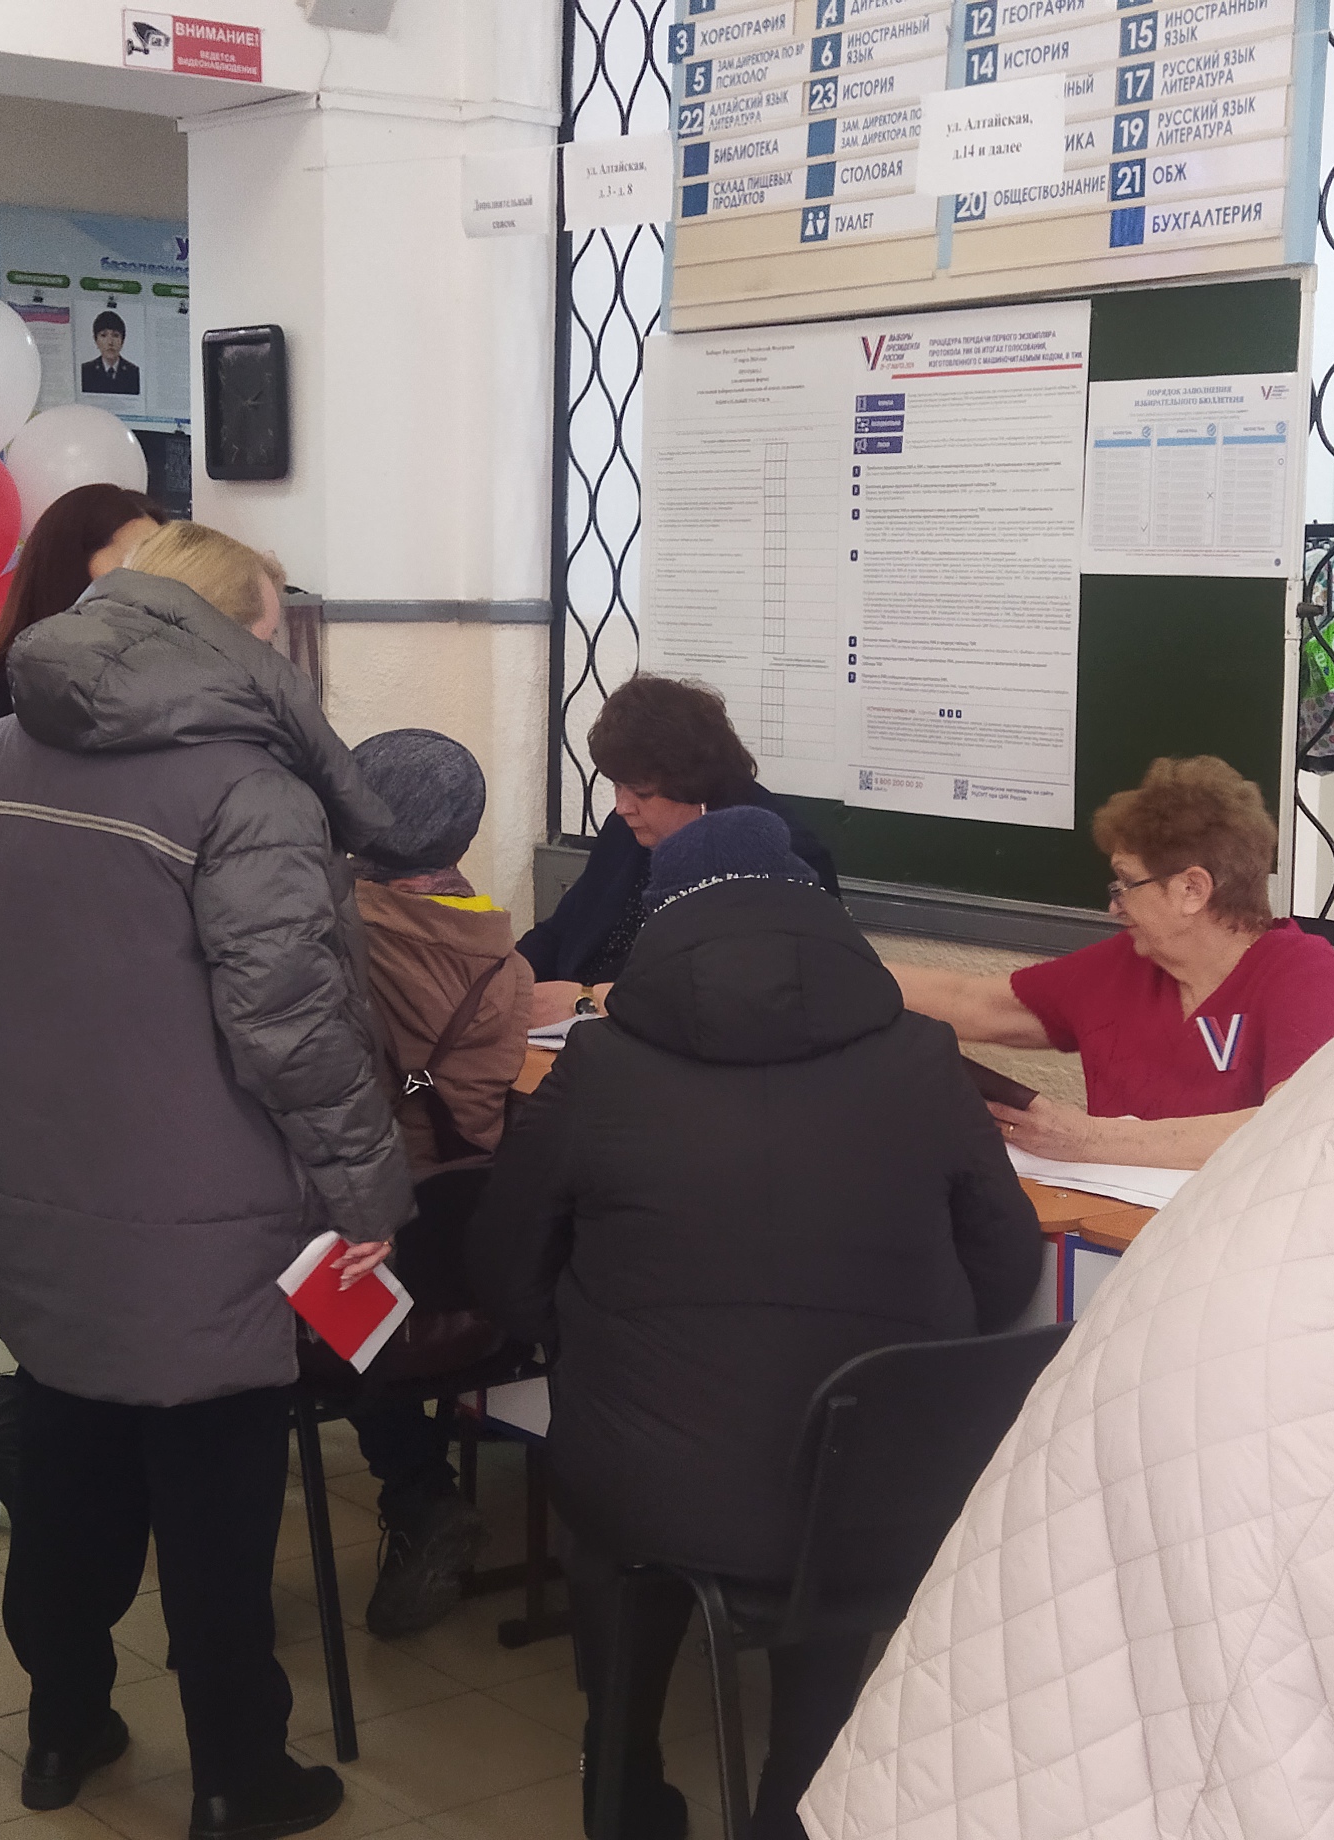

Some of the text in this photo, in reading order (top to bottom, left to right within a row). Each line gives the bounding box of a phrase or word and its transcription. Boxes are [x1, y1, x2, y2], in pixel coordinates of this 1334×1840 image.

[971, 7, 992, 36] 12
[1002, 0, 1085, 25] ГЕОГРАФИЯ
[1165, 0, 1267, 29] ИНОСТРАННЫЙ
[175, 22, 259, 47] ВНИМАНИЕ!
[675, 29, 688, 56] 3
[700, 13, 786, 47] ХОРЕОГРАФИЯ
[847, 14, 931, 49] ИНОСТРАННЫЙ
[1127, 19, 1153, 50] 15
[1164, 26, 1198, 47] ЯЗЫК
[782, 46, 794, 59] ПО
[822, 40, 834, 67] 6
[846, 46, 875, 65] ЯЗЫК
[1004, 41, 1070, 70] ИСТОРИЯ
[1162, 46, 1256, 78] РУССКИЙ ЯЗЫК
[177, 57, 258, 75] ВИДЕОНАБЛЮДЕНИЕ
[716, 66, 769, 90] ПСИХОЛОГ
[971, 51, 994, 81] 14
[693, 67, 705, 92] 5
[842, 76, 895, 100] ИСТОРИЯ
[1124, 69, 1151, 99] 17
[1161, 68, 1234, 96] ЛИТЕРАТУРА
[709, 90, 789, 117] АЛТАЙСКИЙ ЯЗЫК
[810, 82, 836, 110] 23
[680, 108, 703, 134] 22
[708, 110, 762, 132] ЛИТЕРАТУРА
[862, 110, 908, 129] ДИРЕКТОРА
[909, 107, 922, 120] ПО
[946, 113, 1033, 137] ул. Алтайская,
[1158, 96, 1256, 129] РУССКИЙ ЯЗЫК
[861, 126, 908, 146] ДИРЕКТОРА
[909, 124, 922, 137] ПО
[1120, 118, 1144, 148] 19
[1156, 119, 1233, 147] ЛИТЕРАТУРА
[714, 138, 780, 164] БИБЛИОТЕКА
[978, 147, 986, 156] и
[988, 142, 1022, 157] далее
[713, 171, 793, 196] СКЛАД ПИЩЕВЫХ
[841, 160, 903, 184] СТОЛОВАЯ
[1117, 165, 1140, 196] 21
[1153, 162, 1187, 185] ОБЖ
[627, 183, 633, 194] 8
[712, 190, 766, 211] ПРОДУКТОВ
[994, 175, 1106, 207] ОБЩЕСТВОЗНАНИЕ
[957, 193, 984, 218] 20
[1152, 202, 1262, 233] БУХГАЛТЕРИЯ
[835, 212, 874, 233] ТУАЛЕТ
[929, 336, 962, 347] ПРОЦЕДУРА
[982, 345, 1004, 354] ИТОГАХ
[928, 356, 977, 368] ИЗГОТОВЛЕННОГО
